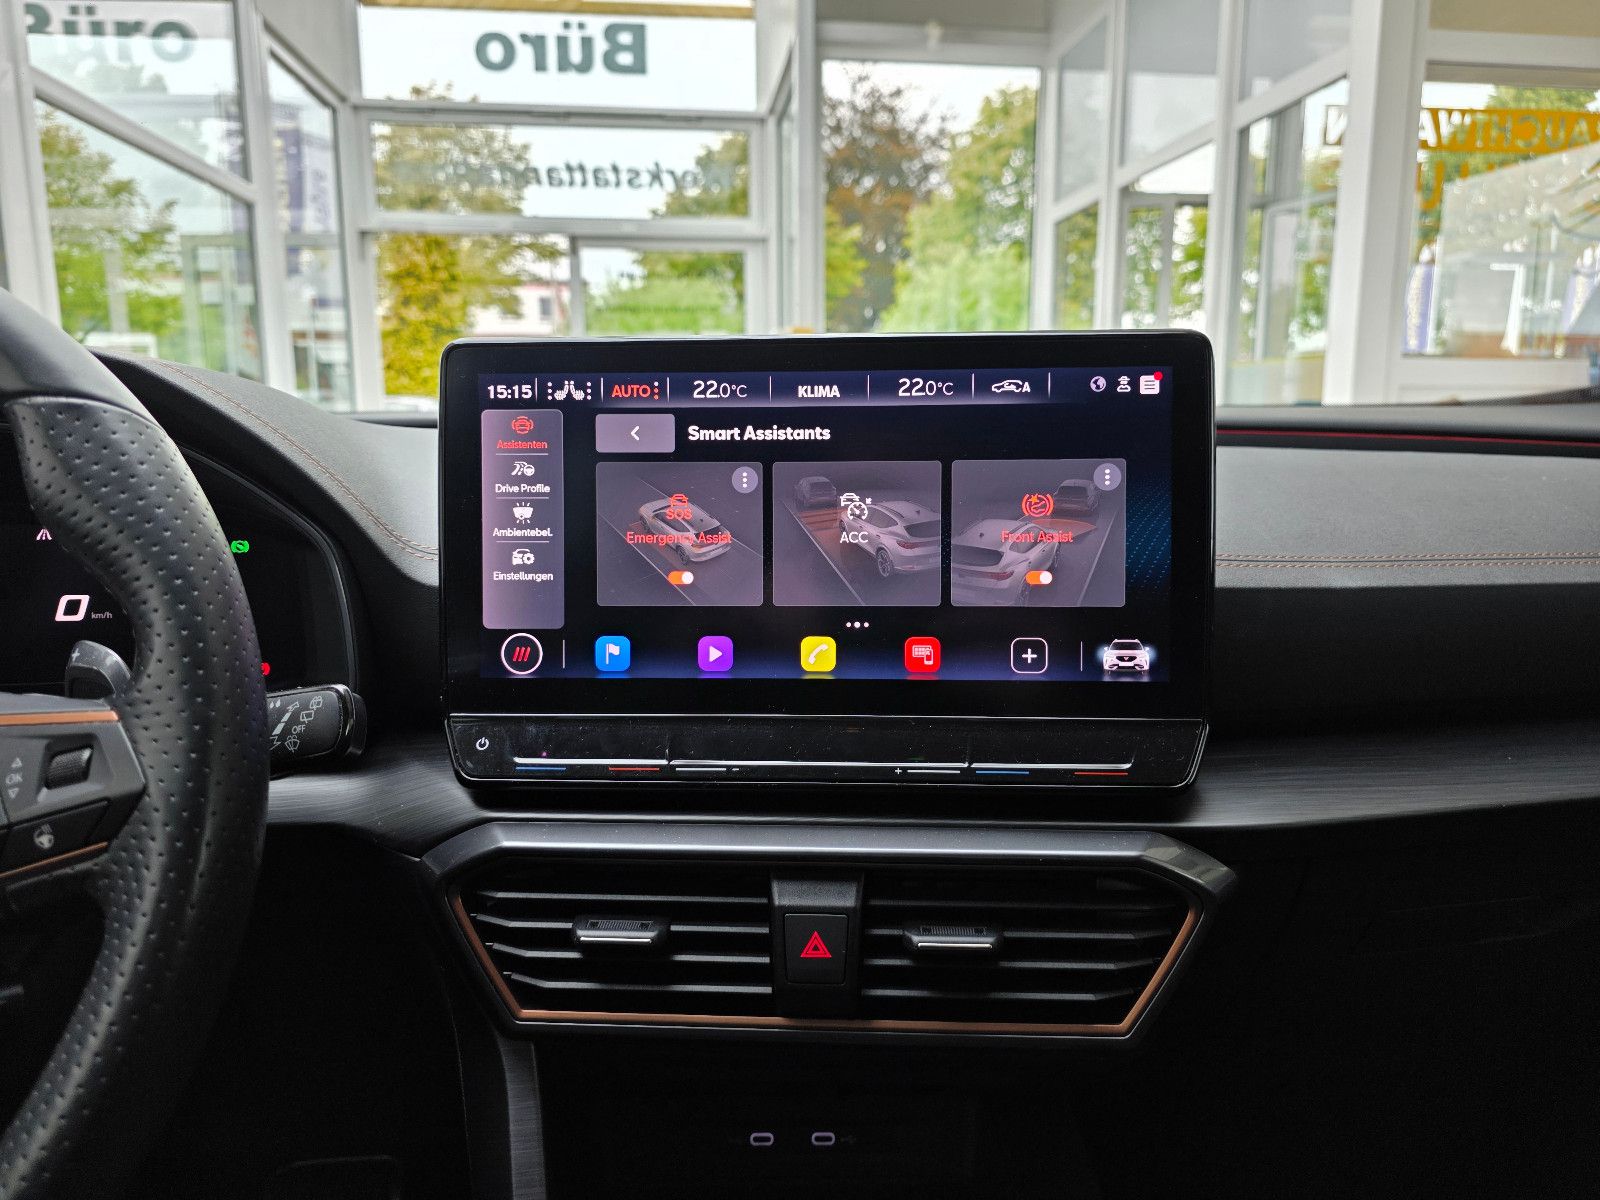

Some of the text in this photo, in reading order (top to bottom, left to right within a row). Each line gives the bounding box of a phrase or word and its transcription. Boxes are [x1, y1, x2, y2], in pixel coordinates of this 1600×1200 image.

[487, 384, 533, 399] 15:15
[611, 384, 651, 398] AUTO
[797, 385, 841, 398] KLIMA
[687, 425, 832, 441] Smart Assistants
[496, 439, 548, 450] Assistenten
[495, 483, 551, 494] Drive Profile
[665, 508, 693, 520] SOS
[626, 531, 733, 546] Emergency Assist
[839, 531, 869, 544] ACC
[1001, 530, 1074, 543] Front Assist
[493, 571, 554, 582] Einstellungen
[91, 611, 113, 620] km/h
[291, 724, 306, 734] OFF
[5, 772, 23, 785] OK
